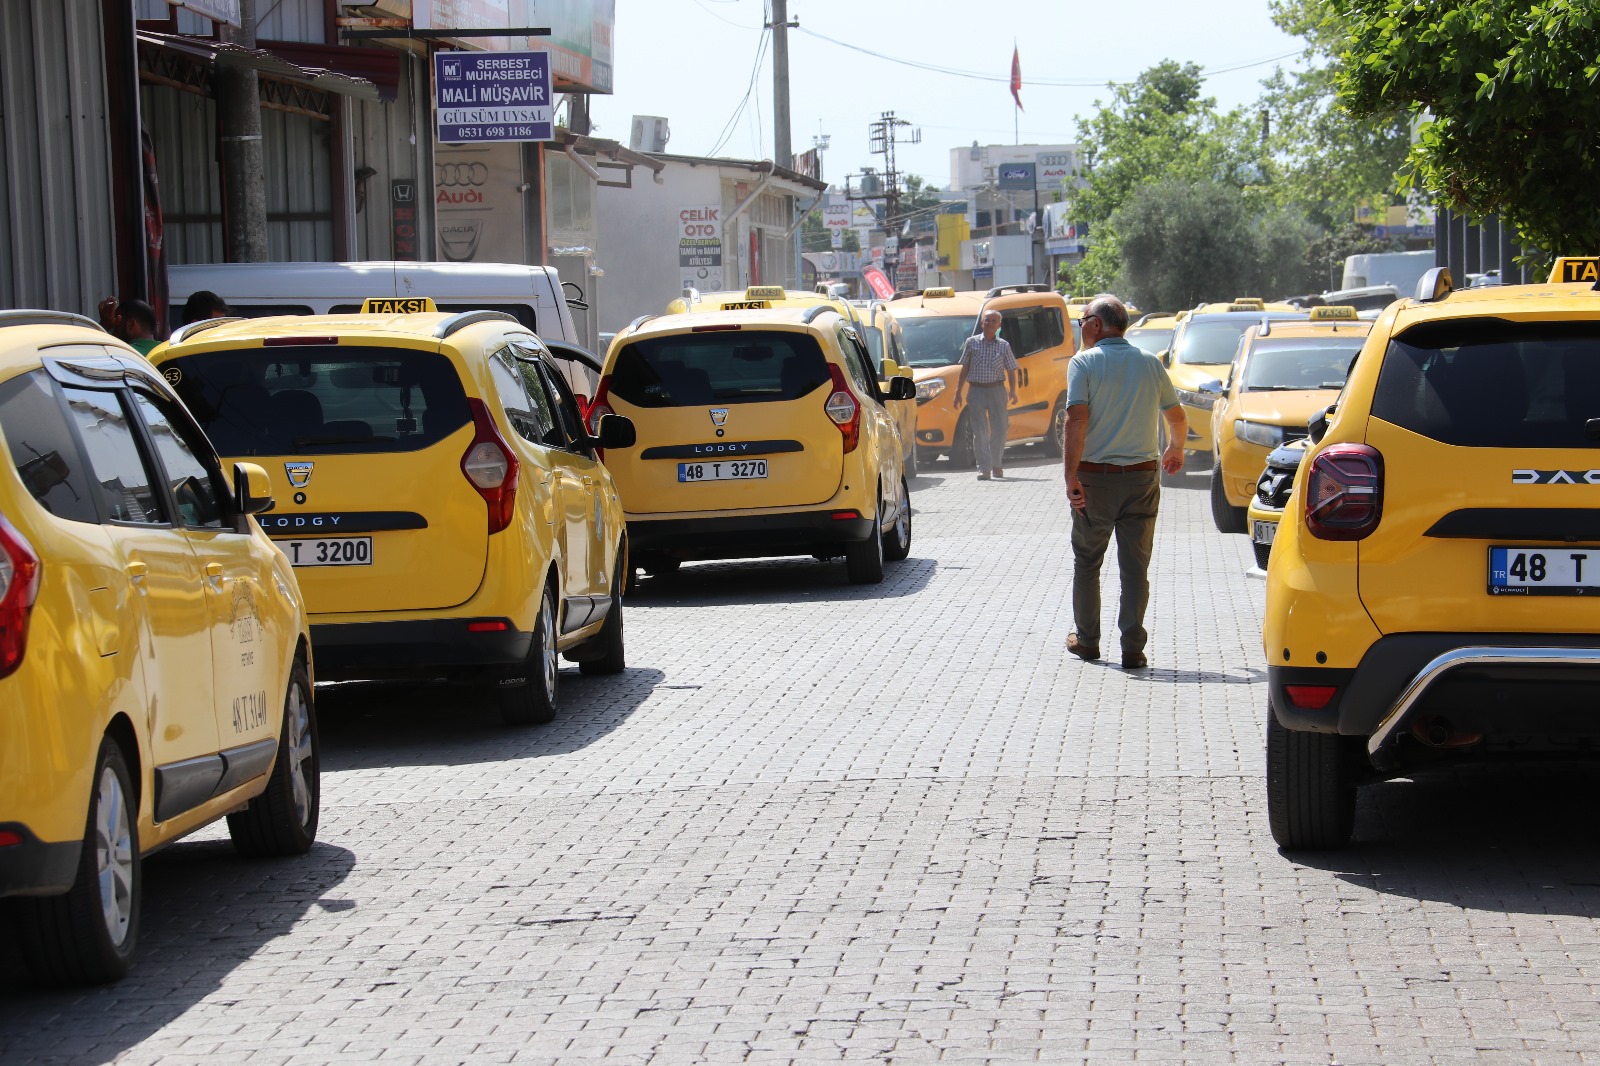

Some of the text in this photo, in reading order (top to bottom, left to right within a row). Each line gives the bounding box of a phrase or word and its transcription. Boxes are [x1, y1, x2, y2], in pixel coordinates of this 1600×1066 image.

[476, 58, 531, 70] SERBEST
[465, 67, 543, 81] MUHASEBECİ
[442, 82, 544, 105] MALİ MÜŞAVİR
[443, 108, 546, 124] GÜLSÜM UYSAL
[458, 125, 532, 138] 0531 698 1186
[1043, 168, 1066, 177] Audi
[436, 188, 483, 204] Audi
[680, 207, 719, 224] ÇELİK
[685, 224, 715, 236] OTO
[680, 237, 720, 246] ÖZEL SERVİS
[680, 246, 696, 256] TAMİR
[704, 247, 720, 255] BAKIM
[165, 372, 179, 381] 53
[695, 443, 748, 453] LODGY
[687, 464, 704, 480] 48
[713, 463, 721, 477] T
[731, 461, 766, 477] 3270
[261, 516, 341, 527] LODGY
[290, 540, 368, 564] T 3200
[1493, 552, 1588, 583] TR 48 T
[232, 690, 267, 734] 48 T 3140
